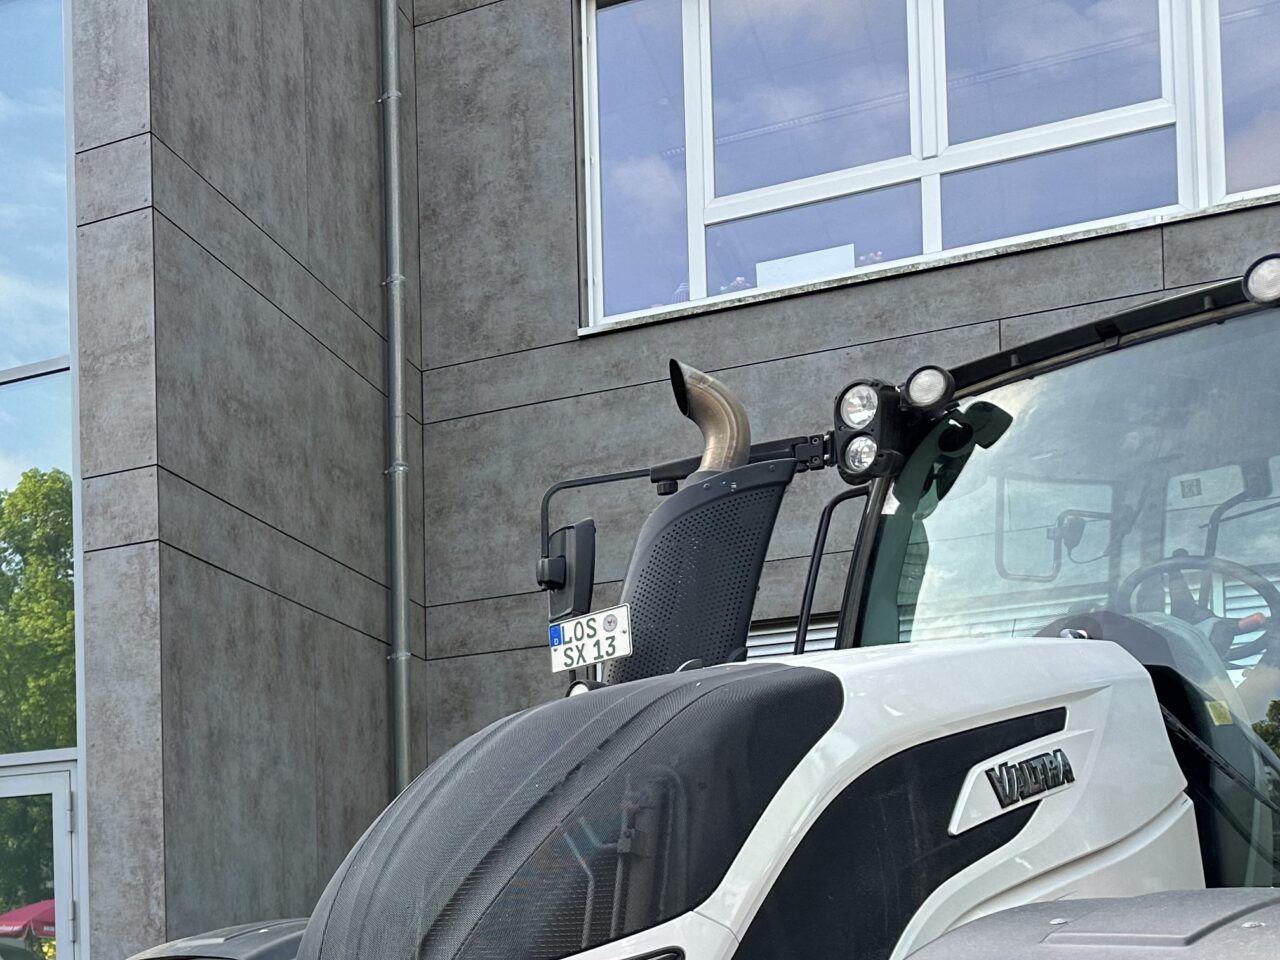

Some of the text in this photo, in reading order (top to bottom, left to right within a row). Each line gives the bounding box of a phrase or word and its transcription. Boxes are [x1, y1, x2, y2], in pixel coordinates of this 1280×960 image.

[562, 617, 597, 645] LOS
[563, 635, 616, 668] SX 13
[985, 748, 1076, 809] VALTRA
